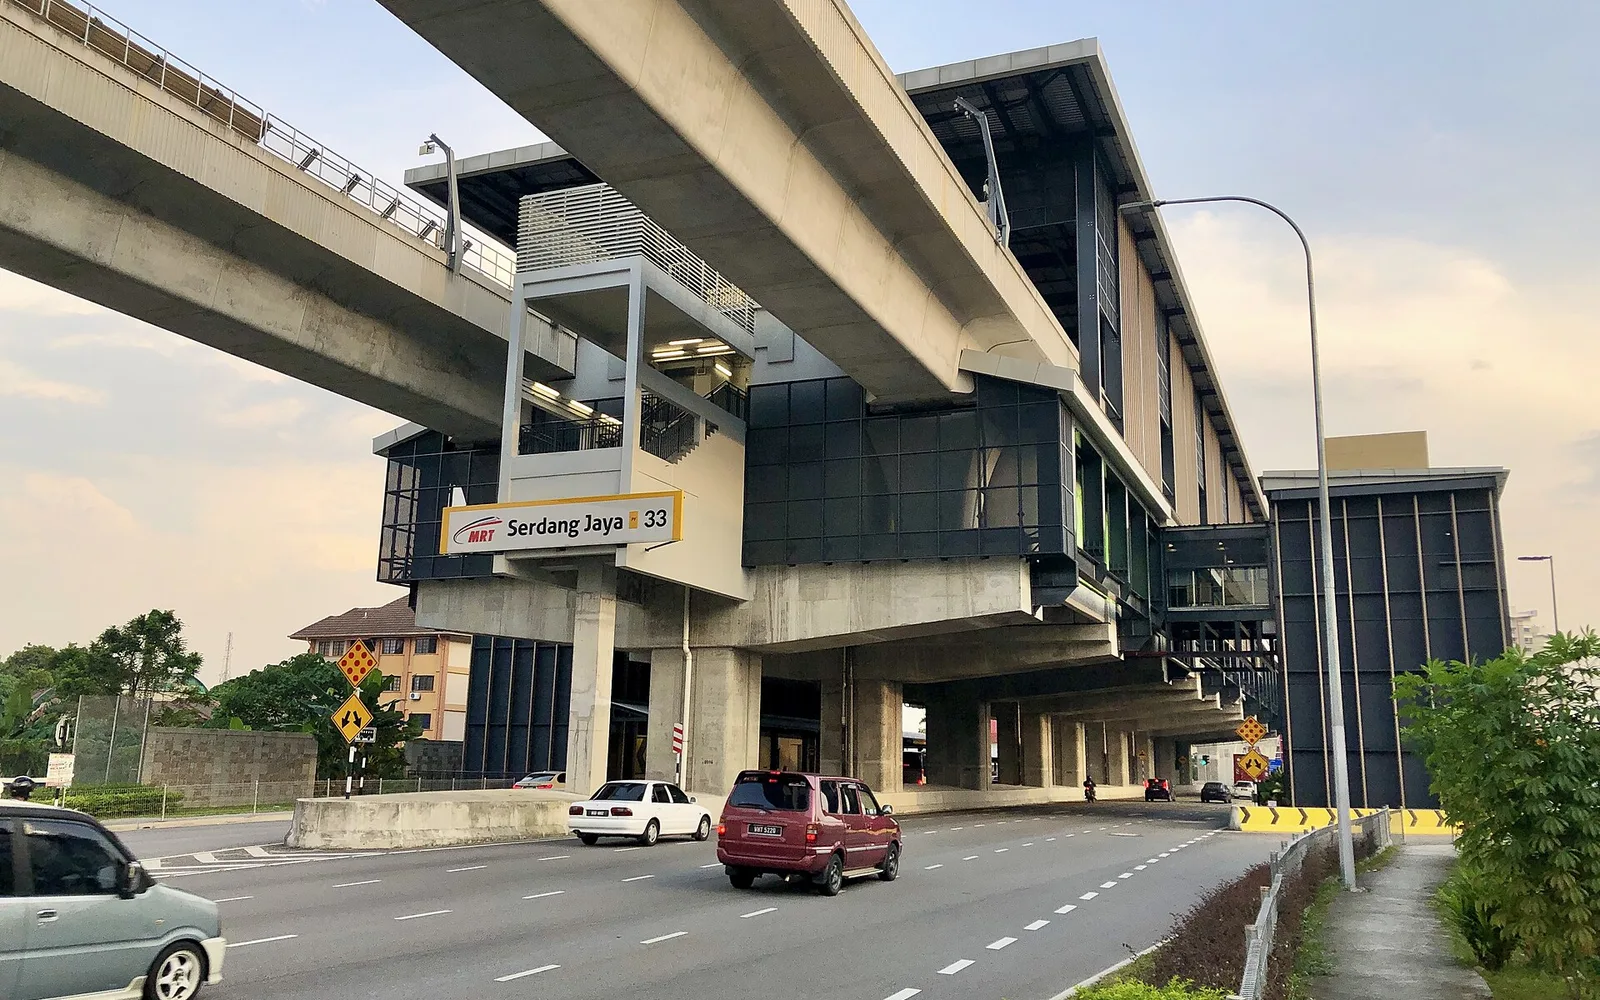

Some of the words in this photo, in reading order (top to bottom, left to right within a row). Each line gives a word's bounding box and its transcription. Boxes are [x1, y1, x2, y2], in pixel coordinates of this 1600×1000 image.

[507, 517, 581, 538] Serdang
[583, 514, 623, 536] Jaya
[643, 509, 667, 528] 33
[468, 529, 495, 543] MRT
